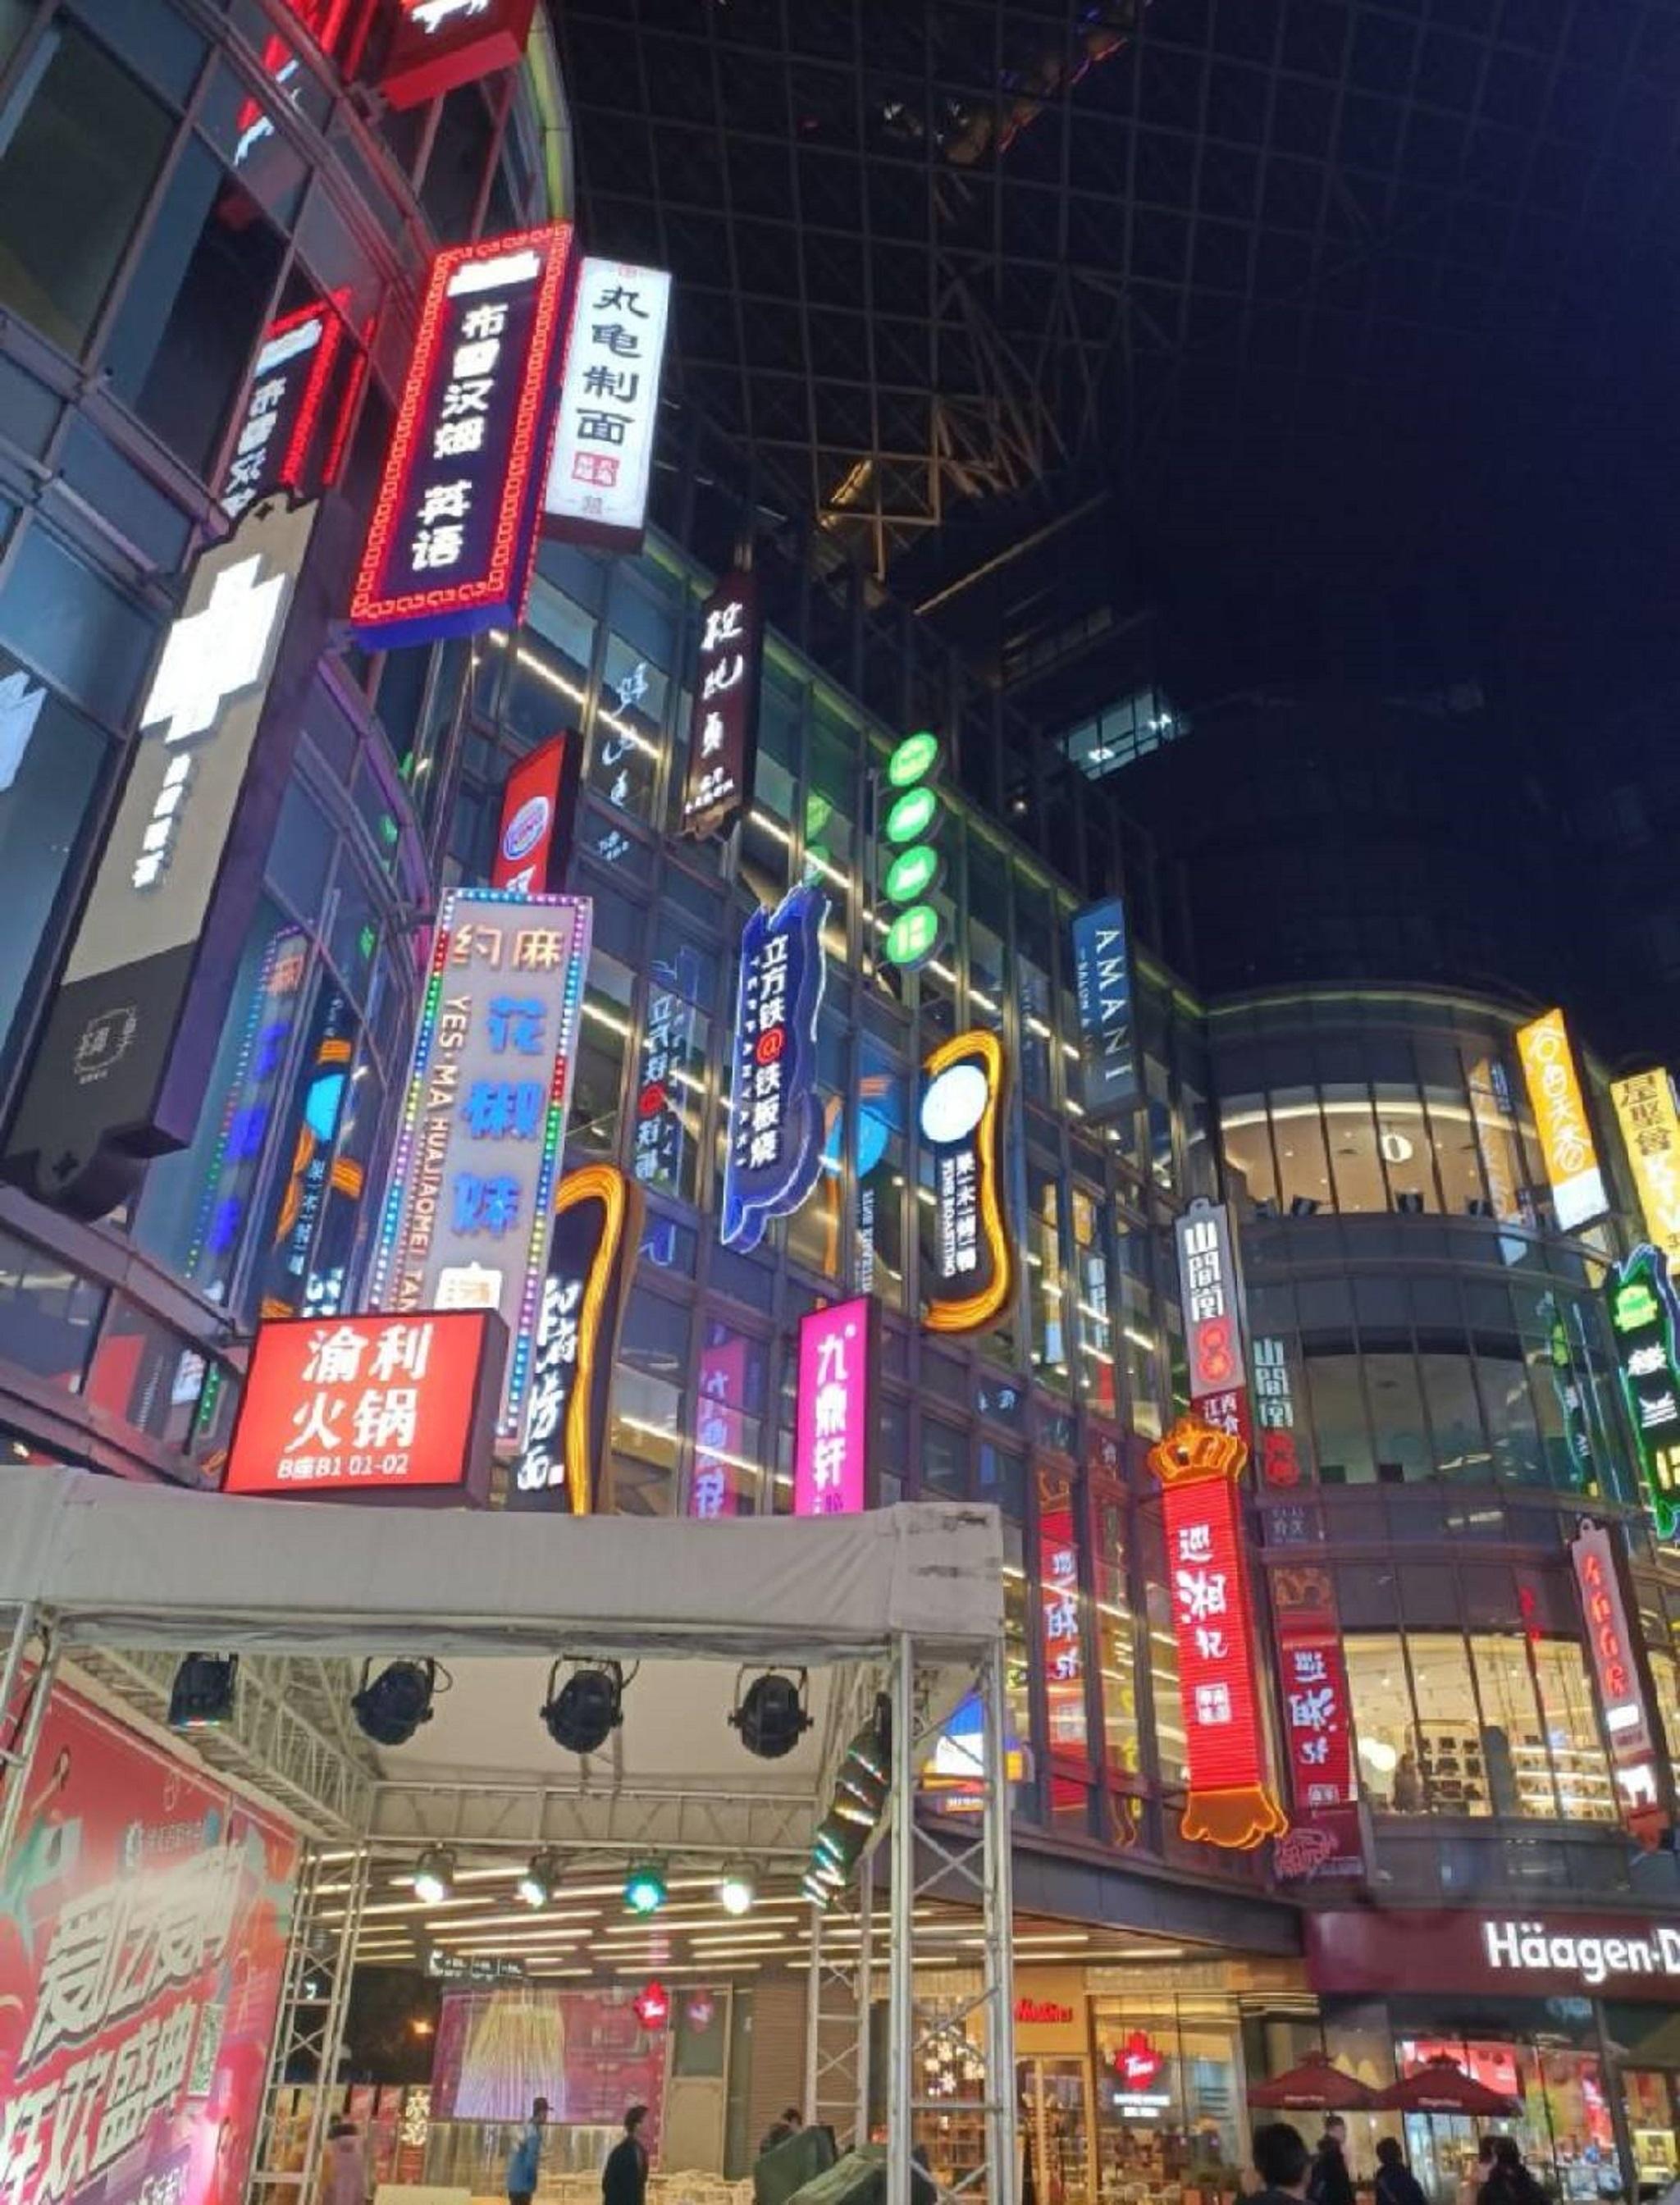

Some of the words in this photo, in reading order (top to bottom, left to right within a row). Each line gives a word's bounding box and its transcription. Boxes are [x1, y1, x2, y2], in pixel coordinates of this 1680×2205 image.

[1095, 929, 1134, 1082] AMANI
[301, 1322, 434, 1385] 渝利
[284, 1388, 418, 1454] 火锅
[349, 1453, 409, 1476] 01-02
